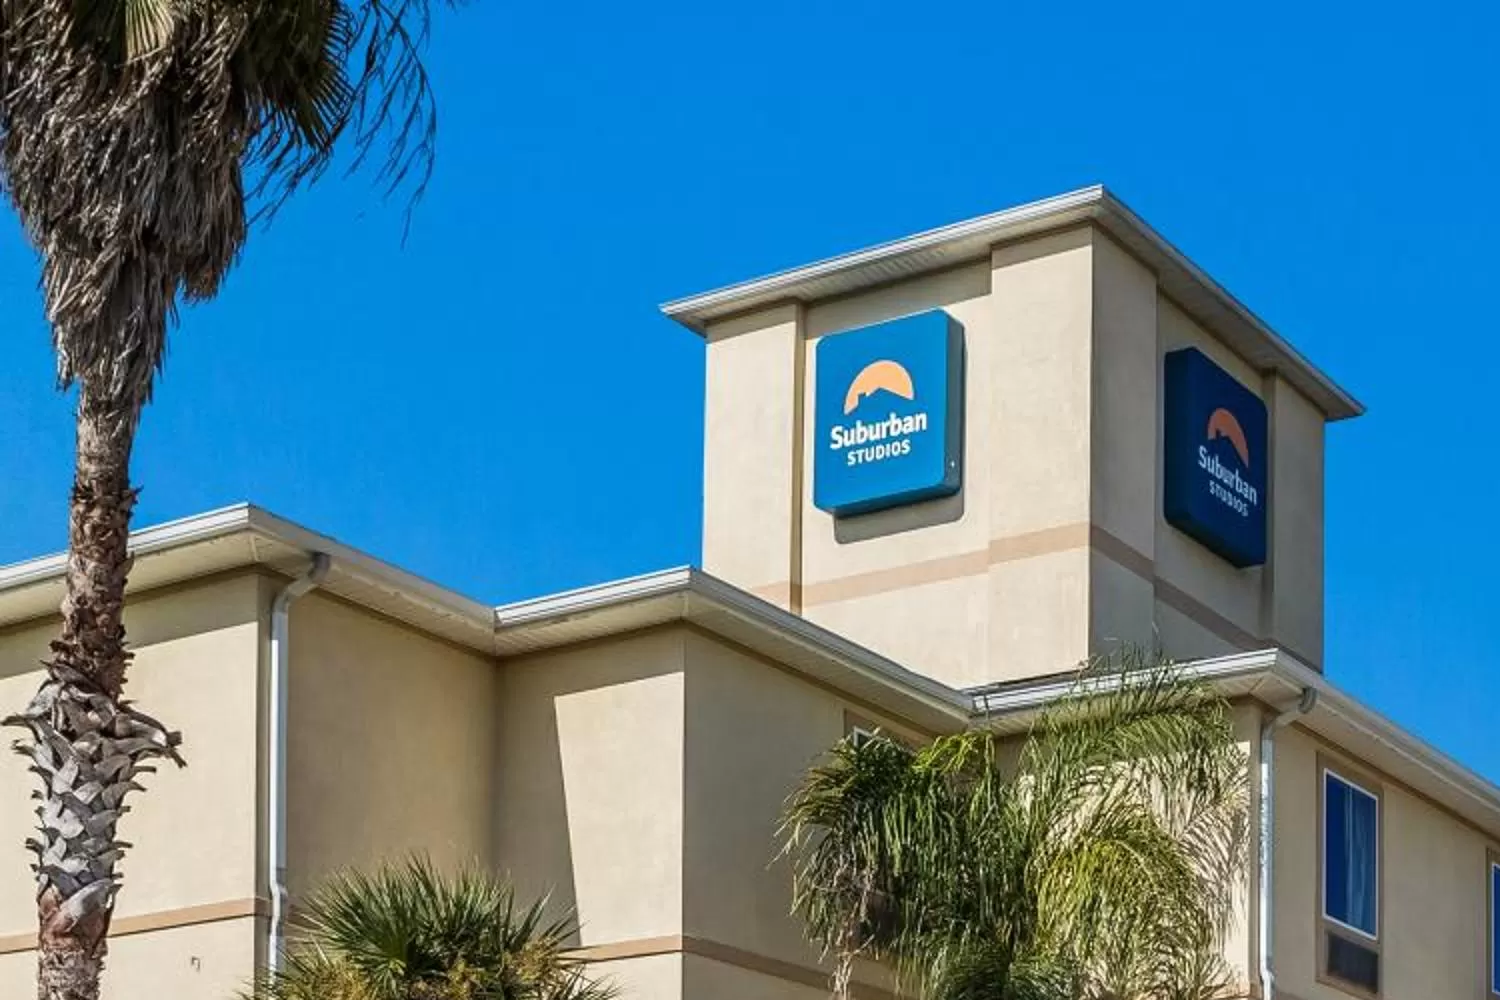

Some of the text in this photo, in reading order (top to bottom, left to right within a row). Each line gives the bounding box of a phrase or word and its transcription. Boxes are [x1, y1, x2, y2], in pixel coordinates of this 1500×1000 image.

[829, 411, 928, 450] Suburban
[846, 438, 911, 467] STUDIOS
[1198, 445, 1258, 506] Suburban
[1208, 479, 1249, 517] STUDIOS
